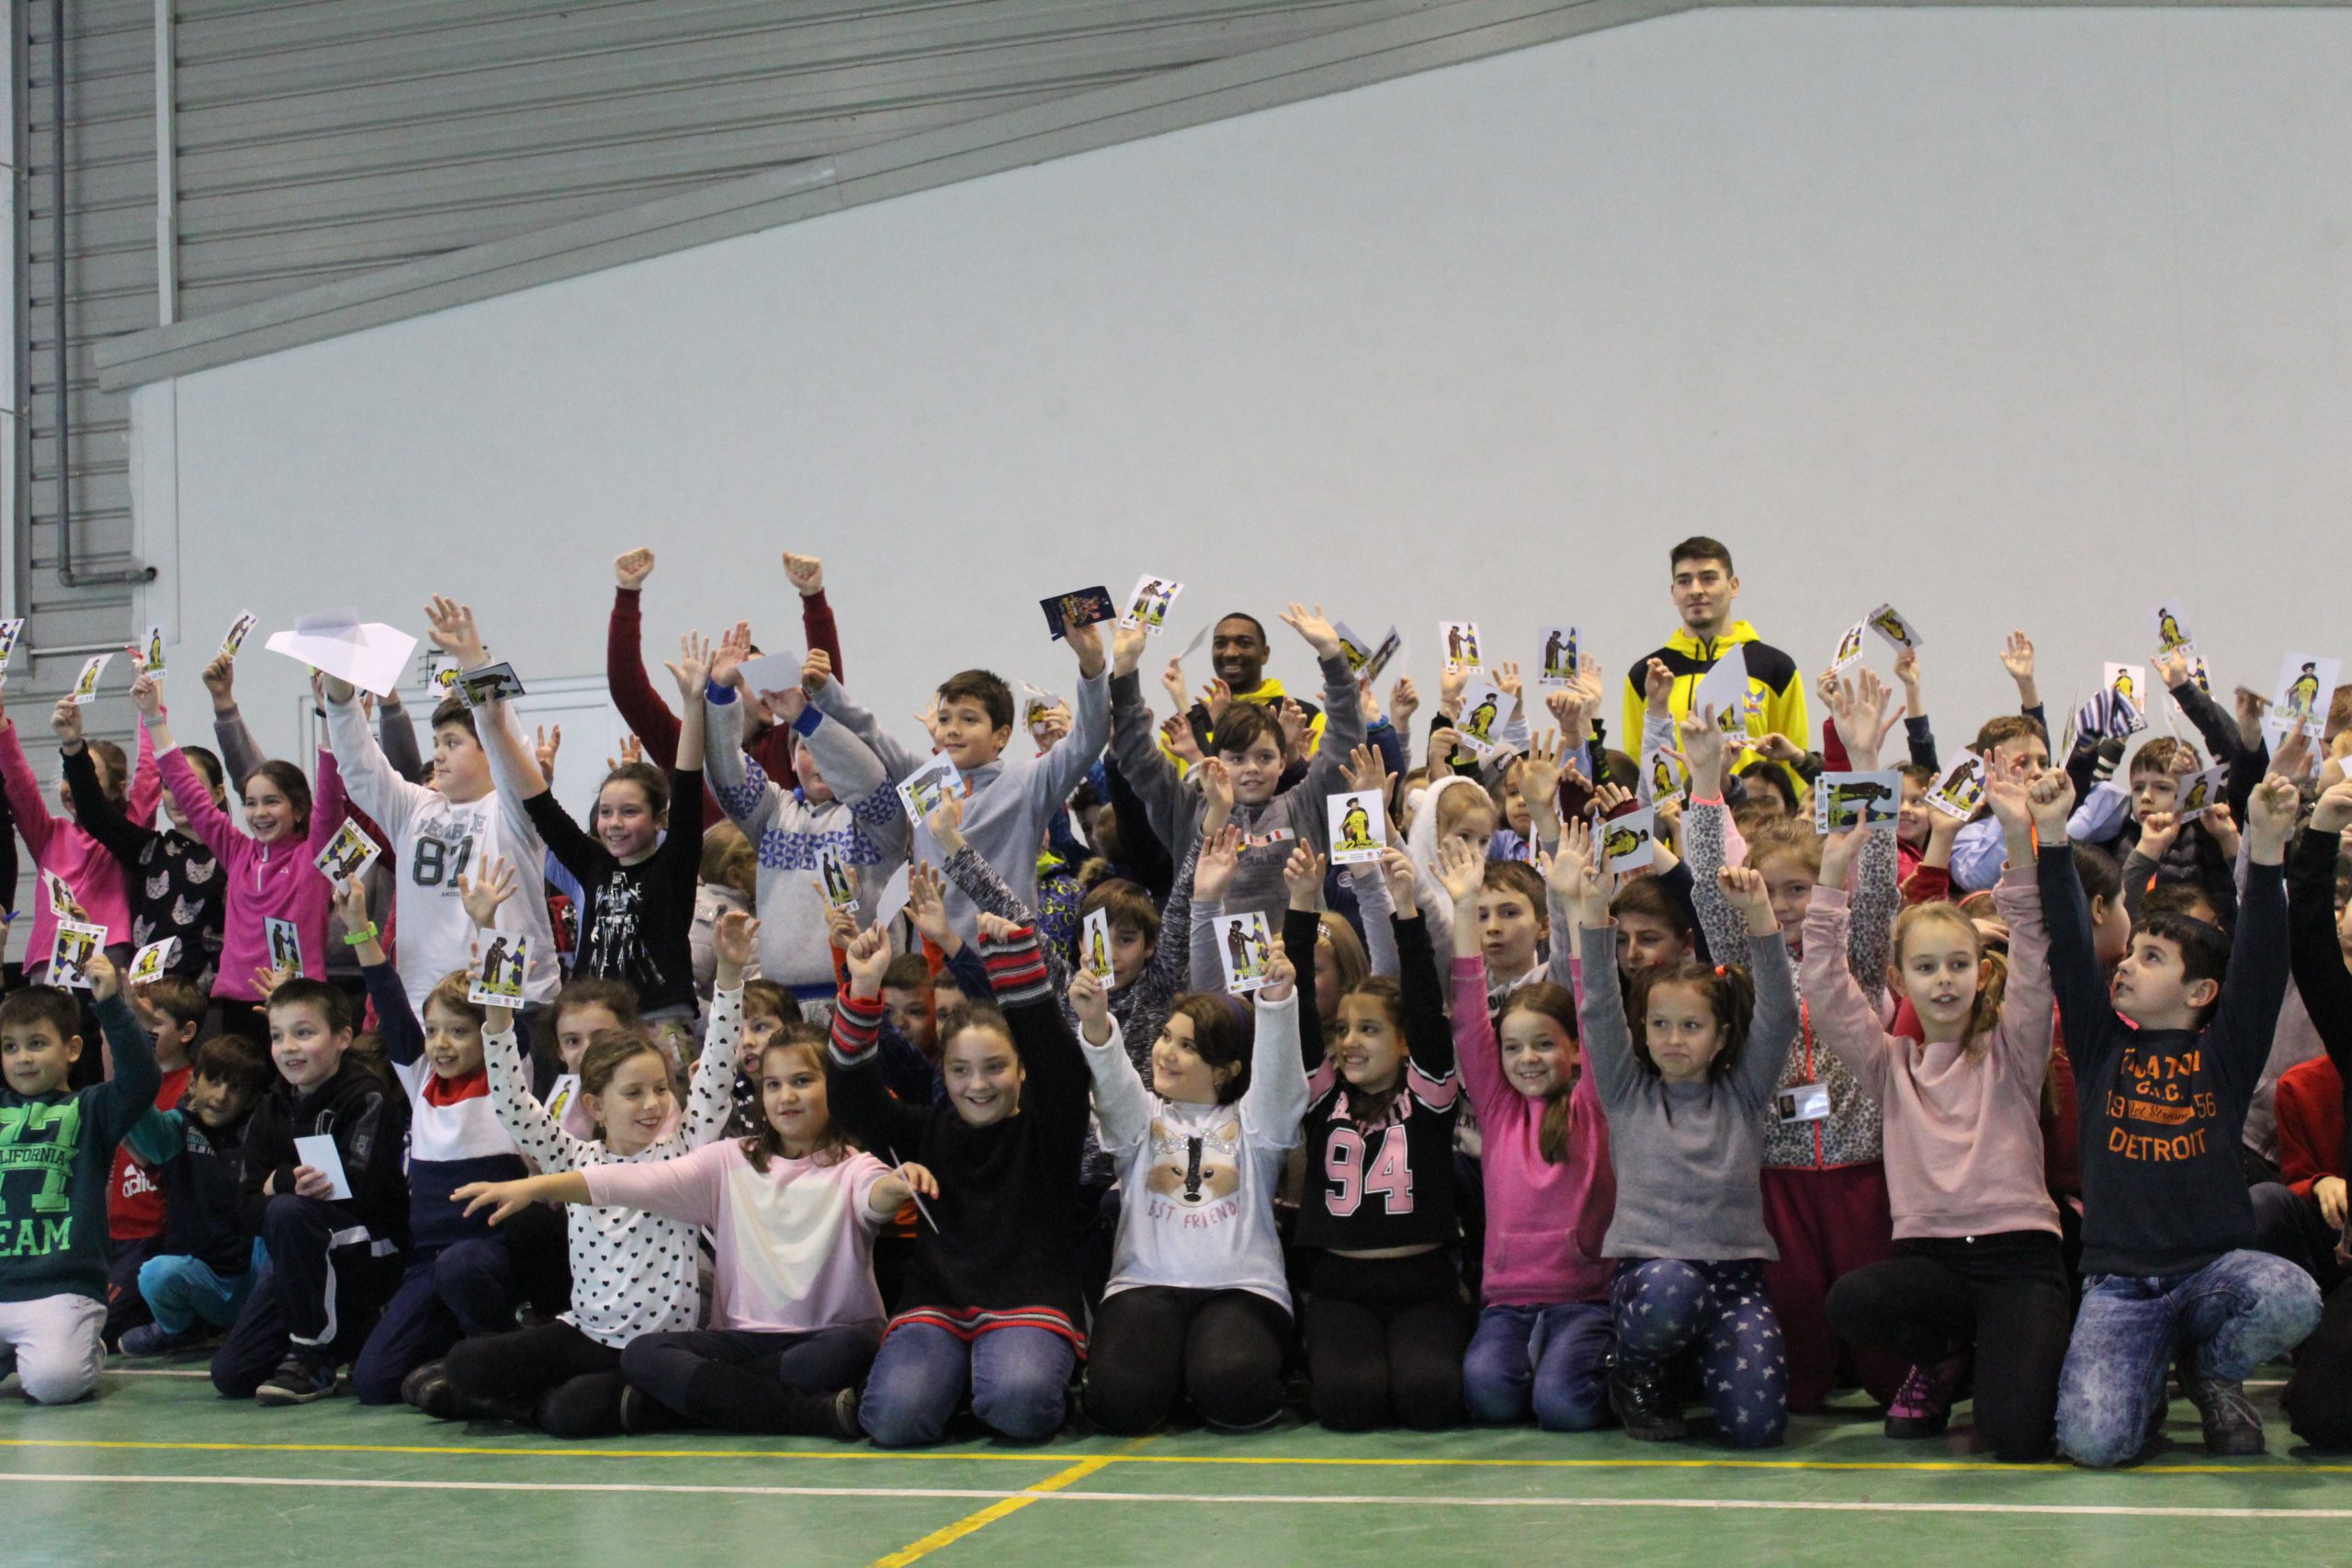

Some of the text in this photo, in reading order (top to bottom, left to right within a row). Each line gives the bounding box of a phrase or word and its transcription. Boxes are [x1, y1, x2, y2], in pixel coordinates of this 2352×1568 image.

[2193, 1091, 2217, 1119] 56
[2109, 1126, 2206, 1162] DETROIT
[1325, 1124, 1414, 1217] 94
